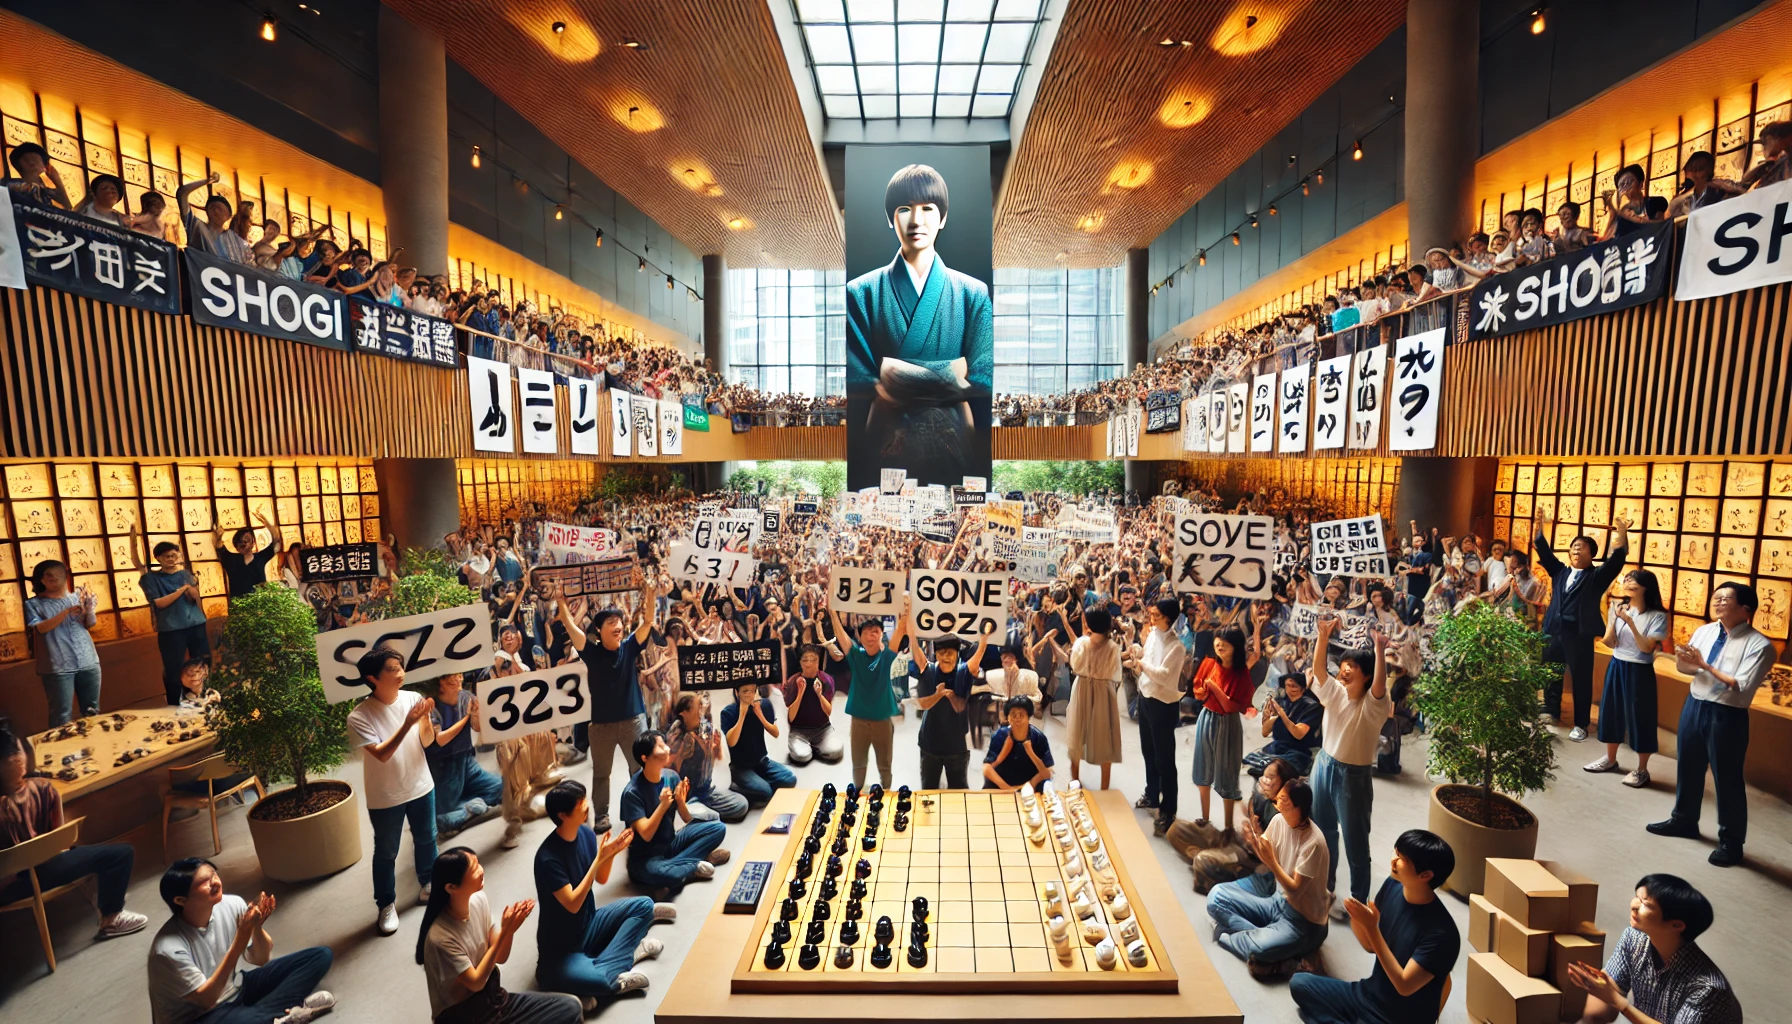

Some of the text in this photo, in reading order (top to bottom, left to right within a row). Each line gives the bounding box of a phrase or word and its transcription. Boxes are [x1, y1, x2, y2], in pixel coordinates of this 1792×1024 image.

[201, 267, 343, 341] SHOGI
[916, 575, 1003, 607] GONE
[487, 673, 585, 731] 323
